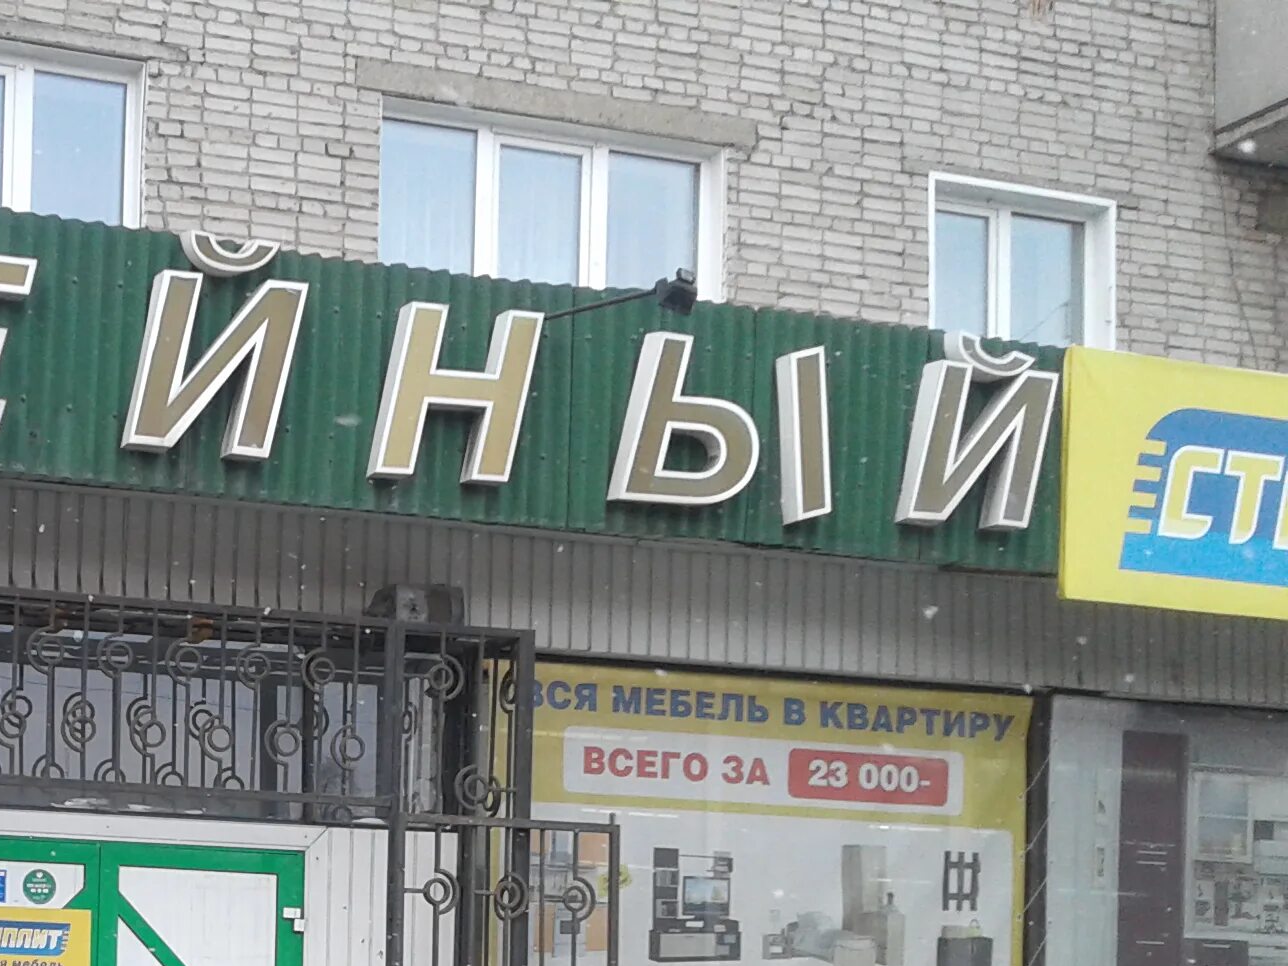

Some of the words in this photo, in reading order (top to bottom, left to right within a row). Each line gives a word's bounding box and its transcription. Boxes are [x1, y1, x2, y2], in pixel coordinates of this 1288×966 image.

[1157, 444, 1288, 551] СТ
[612, 685, 770, 724] МЕБЕЛЬ
[784, 699, 807, 727] В
[819, 702, 1016, 742] КВАРТИРУ
[583, 746, 709, 783] ВСЕГО
[721, 755, 771, 786] ЗА
[808, 759, 849, 788] 23
